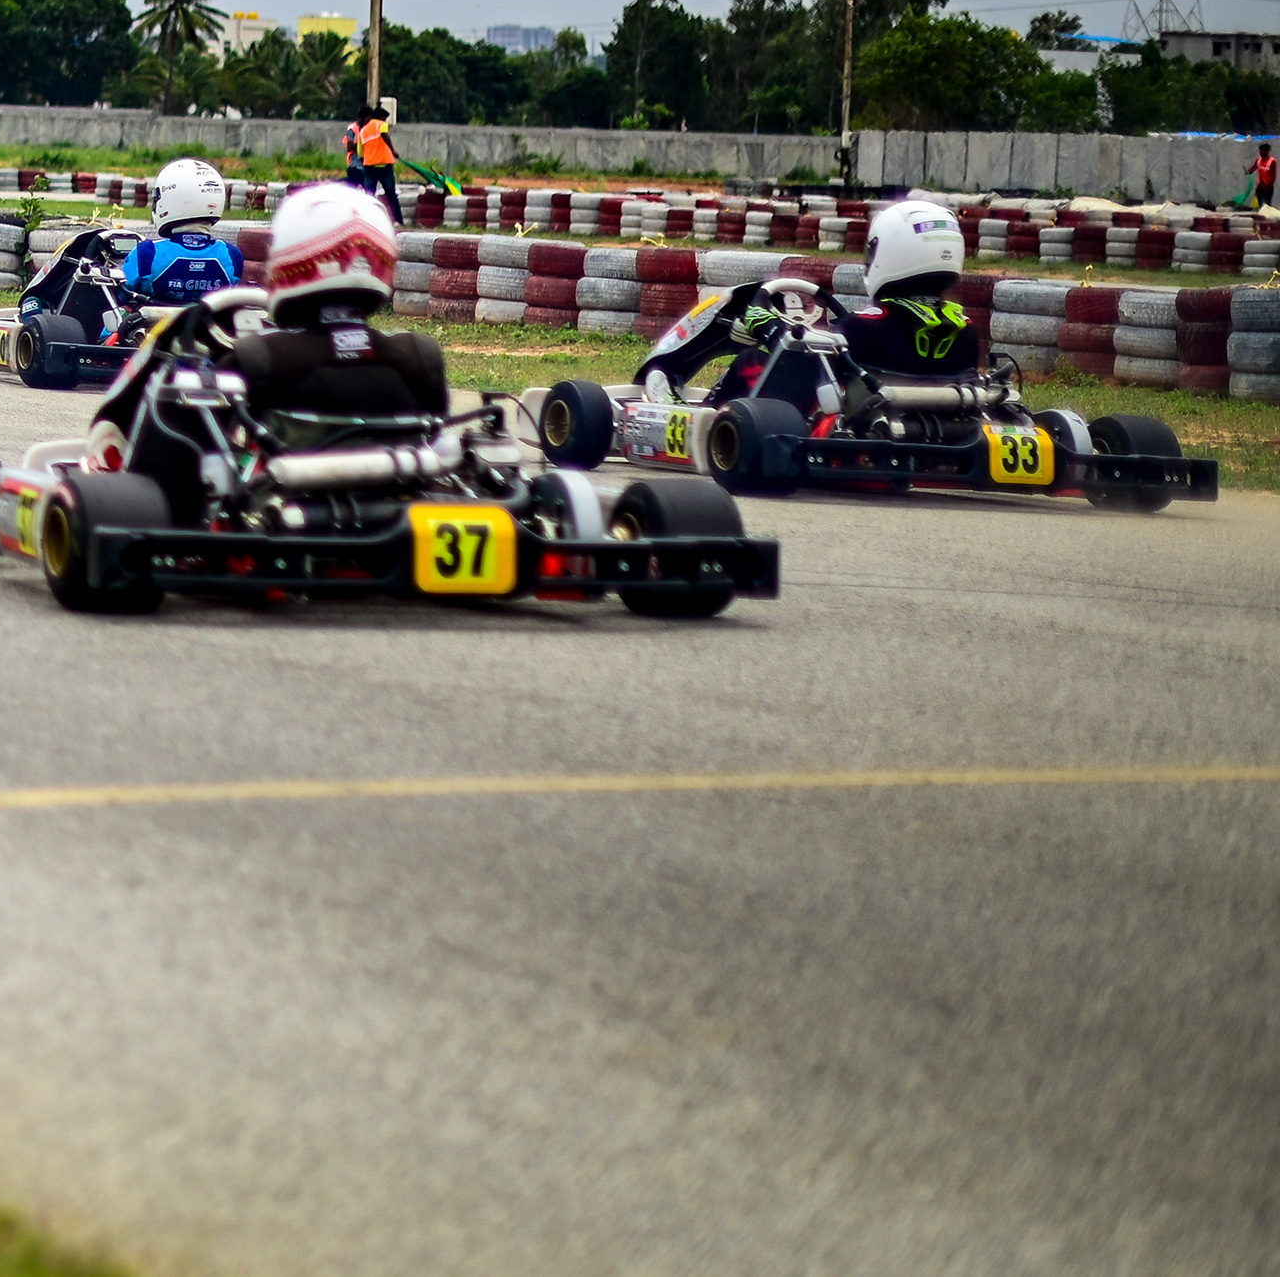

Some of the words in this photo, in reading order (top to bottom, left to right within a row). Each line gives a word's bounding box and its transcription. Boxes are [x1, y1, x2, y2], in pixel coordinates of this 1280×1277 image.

[168, 280, 183, 288] FIA
[185, 279, 221, 291] GIRLS
[189, 262, 206, 271] OMP
[667, 414, 687, 455] 33
[1001, 435, 1040, 474] 33
[435, 523, 490, 579] 37
